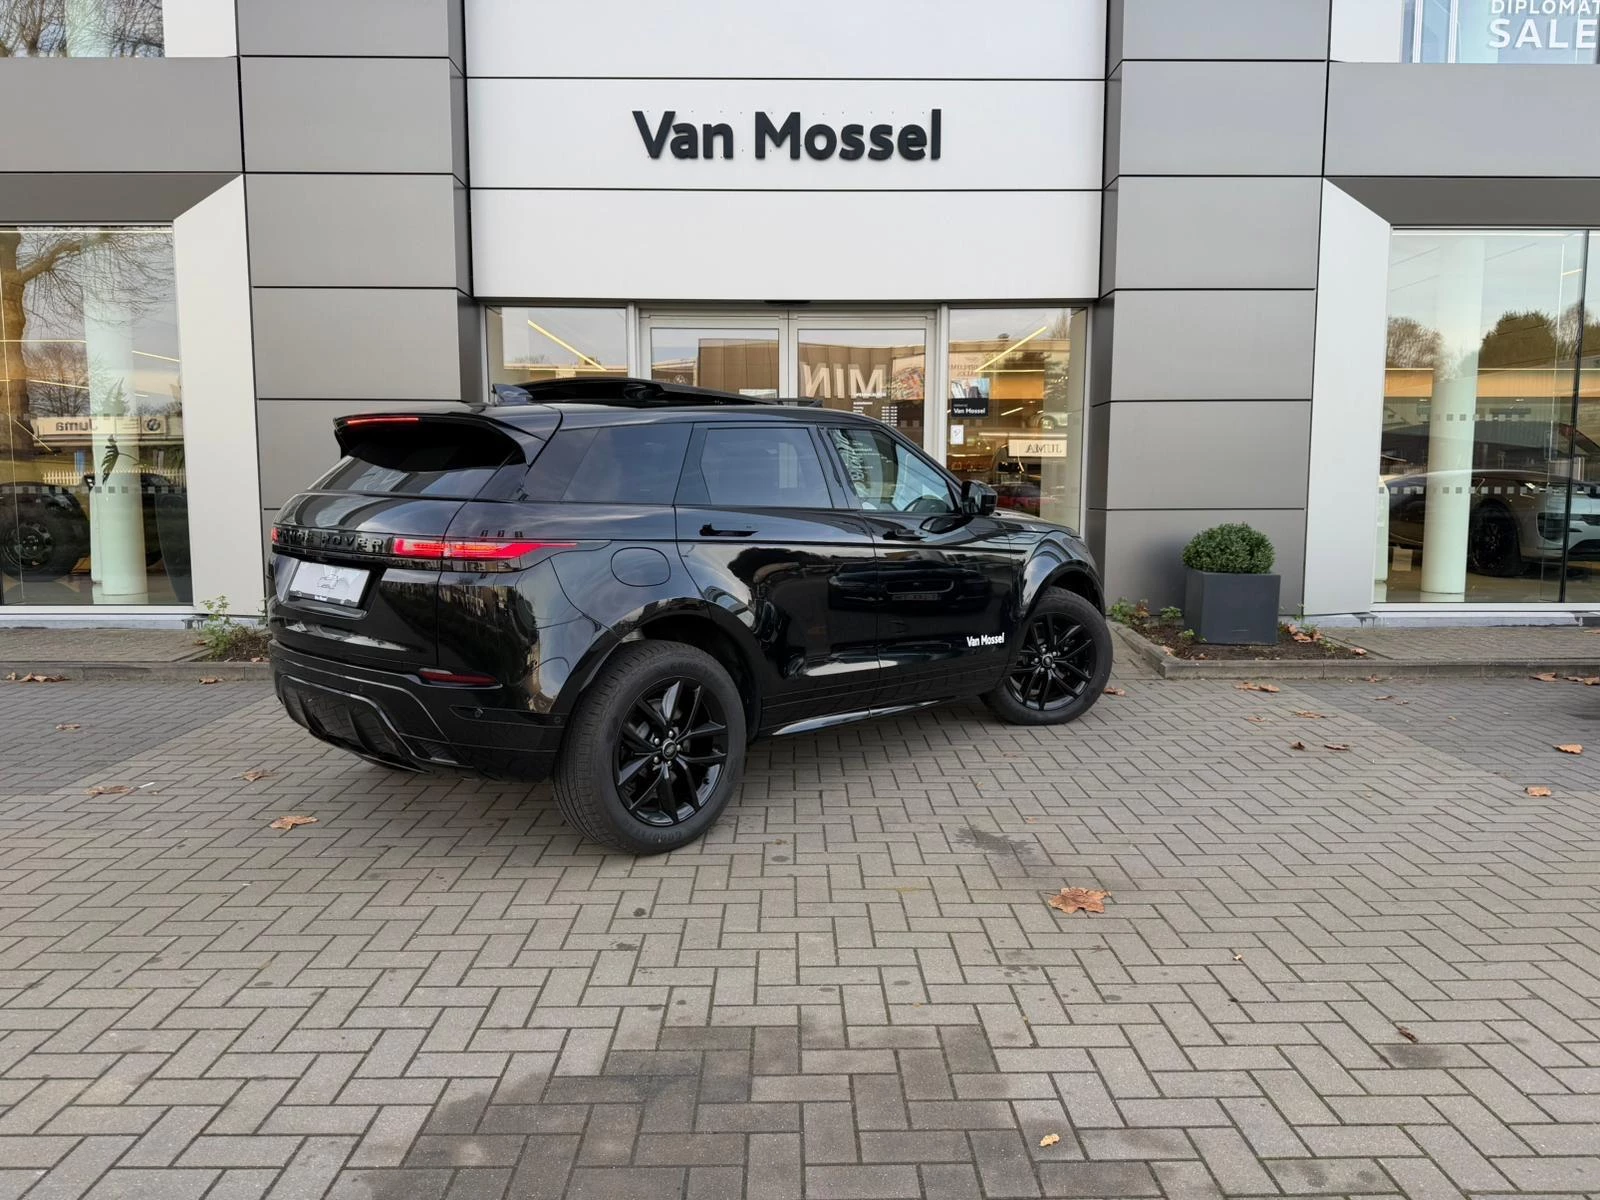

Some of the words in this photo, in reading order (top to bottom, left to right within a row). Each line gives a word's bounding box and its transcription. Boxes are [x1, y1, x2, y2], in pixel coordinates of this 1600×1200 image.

[1488, 18, 1598, 48] SALE
[632, 110, 734, 160] Van
[755, 109, 942, 161] Mossel
[966, 636, 980, 647] Van
[981, 632, 1005, 646] Mossel
